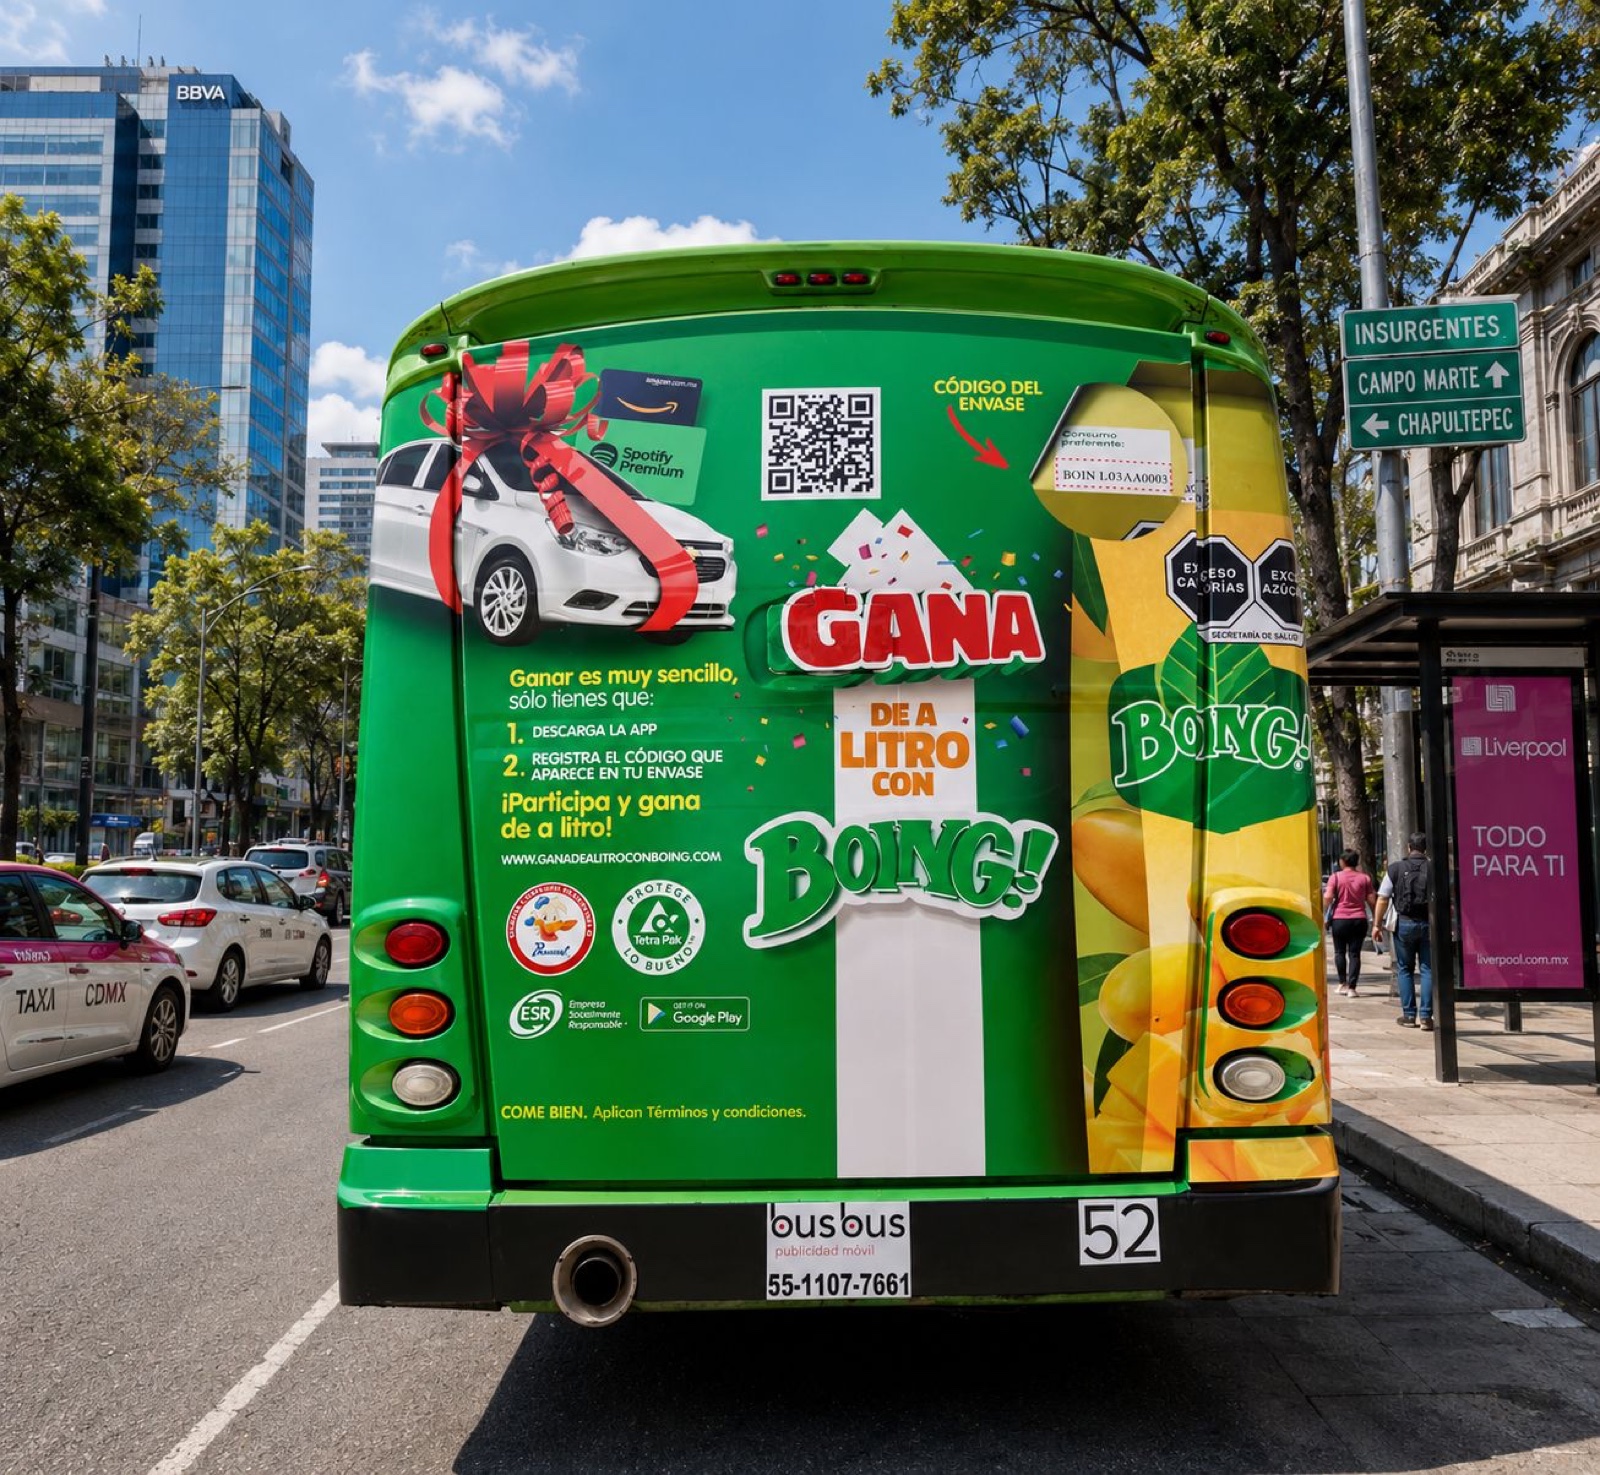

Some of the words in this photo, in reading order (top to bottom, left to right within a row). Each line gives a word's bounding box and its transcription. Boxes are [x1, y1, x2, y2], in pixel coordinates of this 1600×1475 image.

[177, 85, 225, 100] BBVA
[1355, 315, 1500, 345] INSURGENTES
[934, 376, 1007, 394] CÓDIGO
[1011, 380, 1043, 395] DEL
[1358, 370, 1416, 395] CAMPO
[1424, 366, 1480, 391] MARTE
[959, 396, 1025, 411] ENVASE
[1398, 407, 1514, 436] CHAPULTEPEC
[1061, 439, 1125, 448] preferente:
[1062, 430, 1117, 439] Consumo
[623, 447, 673, 465] Spotify
[619, 460, 684, 479] Premium
[780, 586, 1046, 671] GANA
[510, 669, 574, 688] Ganar
[578, 671, 602, 687] es
[608, 668, 653, 688] muy
[657, 663, 738, 686] sencillo,
[509, 689, 547, 710] sólo
[551, 689, 608, 708] tienes
[612, 690, 654, 711] que:
[870, 702, 910, 727] DE
[915, 702, 938, 727] A
[507, 722, 524, 744] 1.
[532, 724, 605, 739] DESCARGA
[609, 724, 626, 736] LA
[630, 723, 657, 736] APP
[1110, 699, 1312, 789] BOING!
[840, 731, 970, 769] LITRO
[1485, 737, 1567, 760] Liverpool
[503, 754, 525, 777] 2.
[532, 751, 601, 766] REGISTRA
[605, 751, 620, 764] EL
[624, 747, 687, 764] CÓDIGO
[691, 749, 723, 764] QUE
[531, 766, 595, 781] APARECE
[599, 766, 619, 779] EN
[622, 766, 643, 779] TU
[647, 765, 703, 779] ENVASE
[871, 770, 934, 797] CON
[501, 790, 610, 817] ¡Participa
[617, 794, 632, 816] y
[638, 793, 701, 817] gana
[501, 816, 531, 839] de
[538, 821, 553, 838] a
[561, 815, 612, 838] litro!
[1471, 826, 1546, 848] TODO
[501, 851, 722, 866] WWW.GANADEALITROCONBOING.COM
[1473, 854, 1538, 876] PARA
[1544, 854, 1565, 876] TI
[746, 814, 1059, 945] BOING!
[626, 882, 692, 905] PROTEGE
[633, 934, 660, 946] Tetra
[663, 934, 683, 946] Pak
[623, 947, 639, 964] LO
[645, 946, 693, 971] BUENO
[1477, 953, 1569, 968] liverpool.com.mx
[85, 981, 127, 1007] CDMX
[521, 1006, 551, 1021] ESR
[673, 1011, 716, 1026] Google
[717, 1011, 742, 1026] Play
[501, 1105, 545, 1119] COME
[550, 1105, 587, 1119] BIEN.
[593, 1105, 642, 1122] Aplican
[647, 1104, 708, 1118] Términos
[712, 1107, 720, 1121] y
[723, 1104, 807, 1118] condiciones.
[1083, 1202, 1158, 1260] 52
[775, 1244, 838, 1259] publicidad
[843, 1244, 875, 1256] móvil
[768, 1273, 909, 1297] 55-1107-7661
